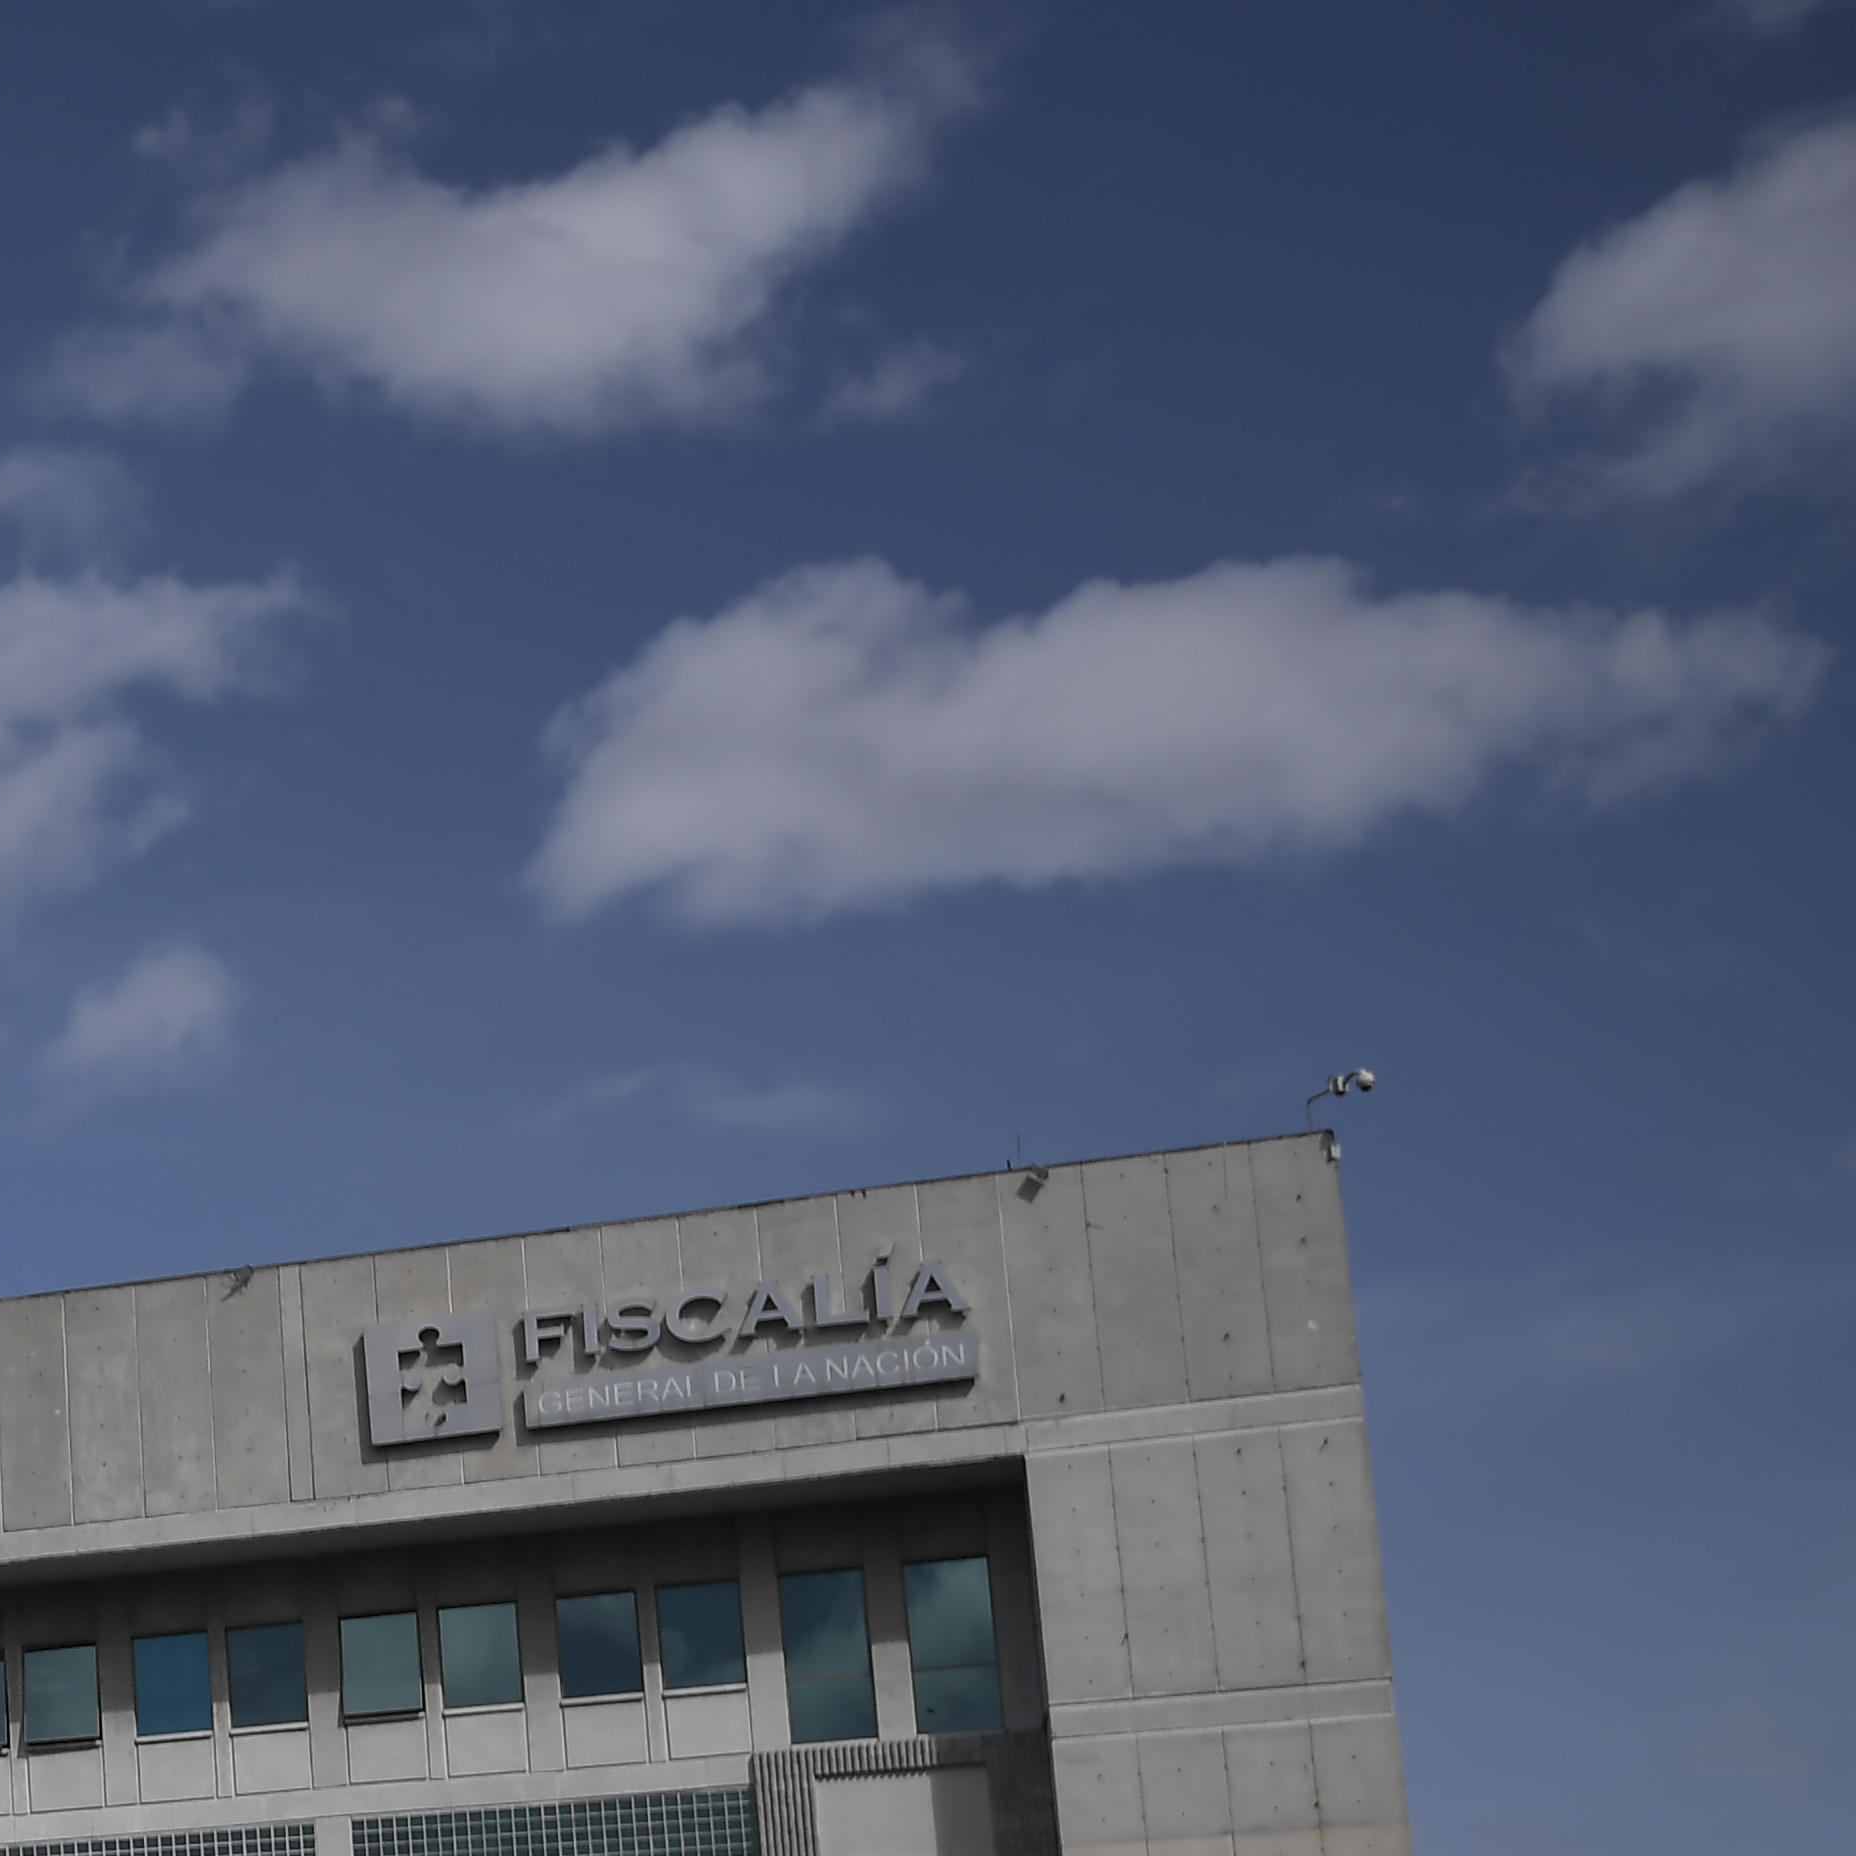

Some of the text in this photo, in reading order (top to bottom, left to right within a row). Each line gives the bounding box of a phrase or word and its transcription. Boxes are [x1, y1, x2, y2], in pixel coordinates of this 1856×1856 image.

[524, 1243, 970, 1362] FISCALÍA
[538, 1374, 692, 1415] GENERAL
[712, 1368, 763, 1394] DE
[825, 1340, 967, 1379] NACIÓN
